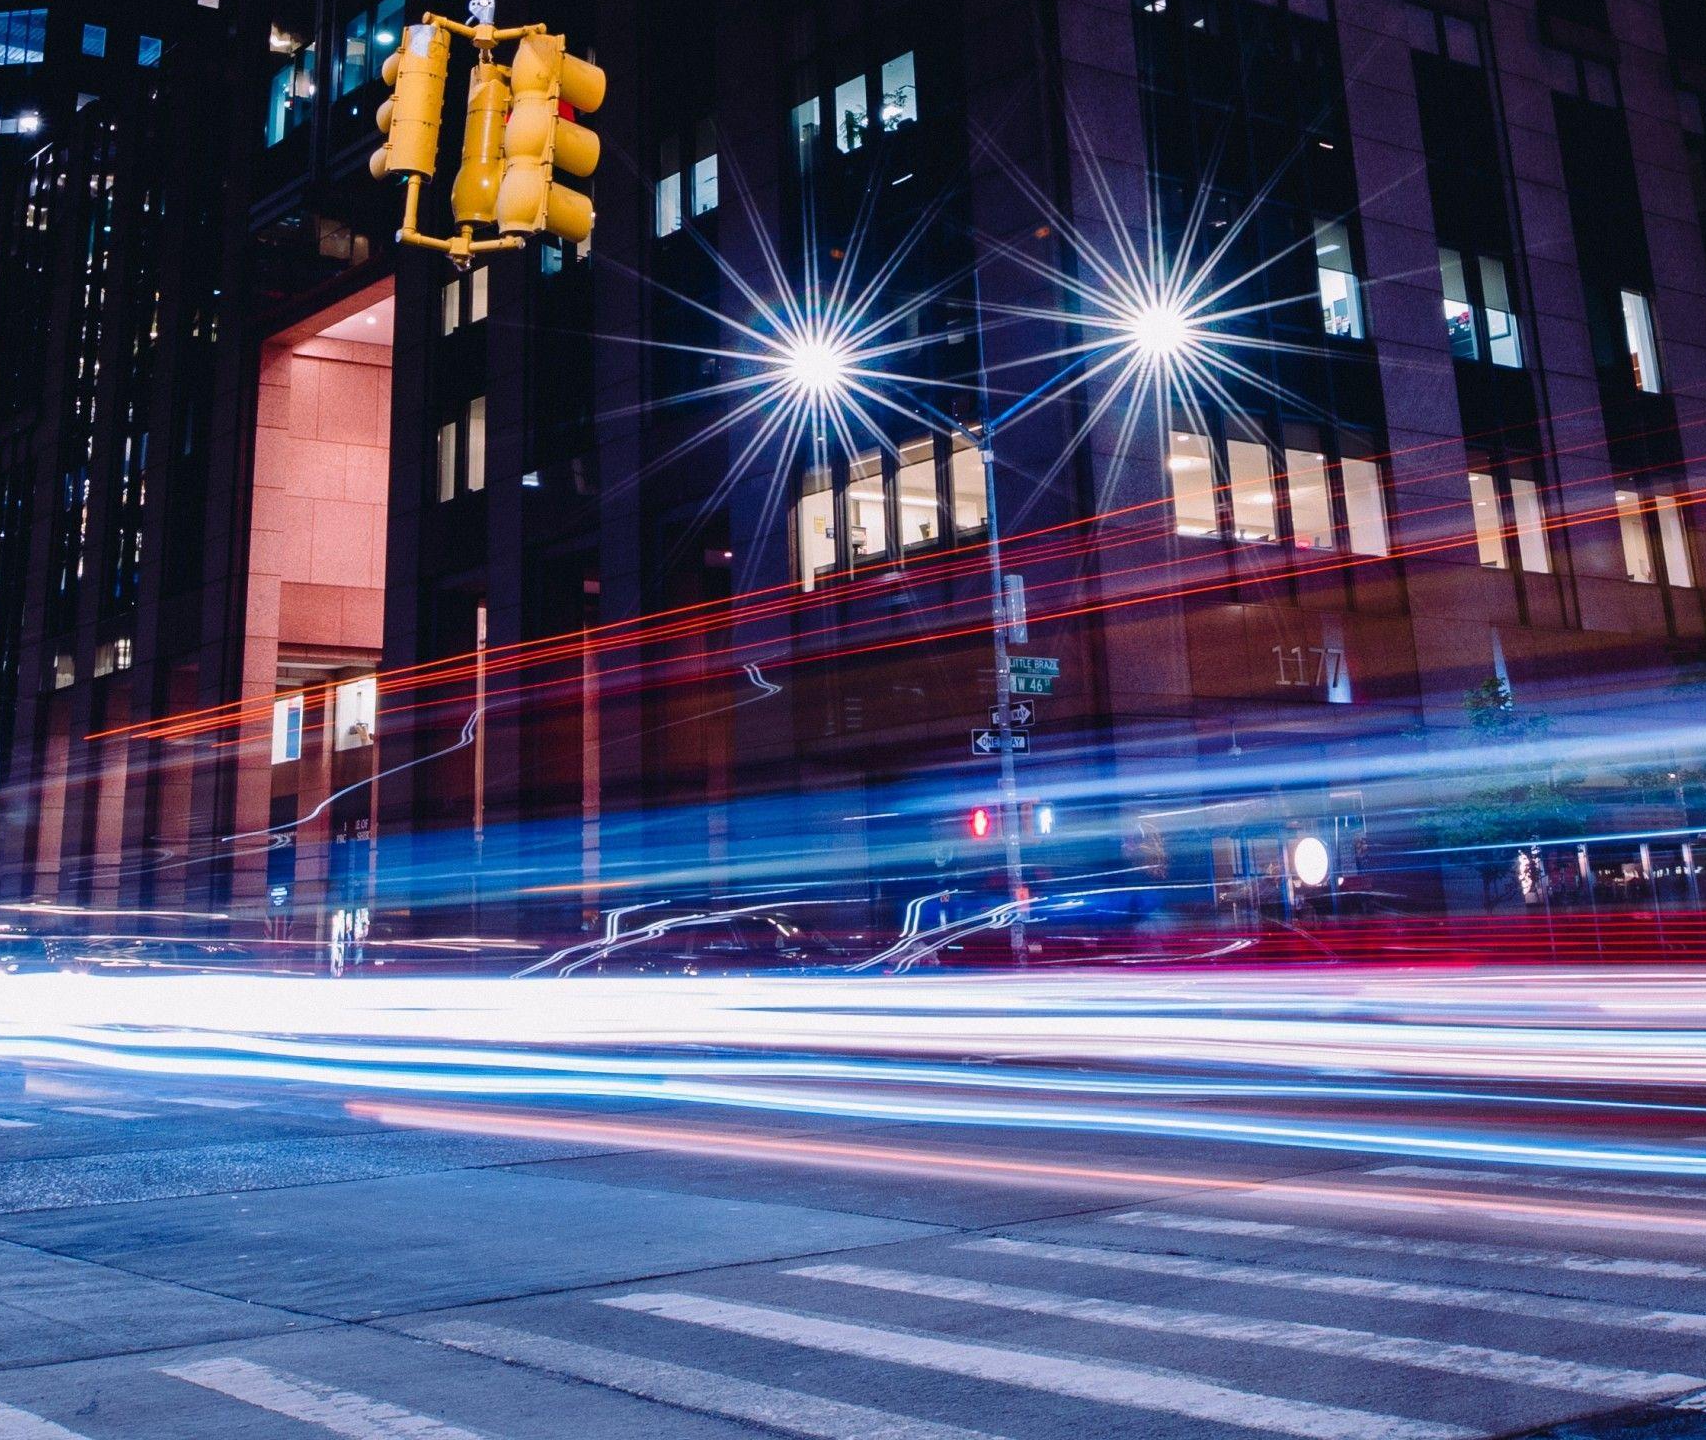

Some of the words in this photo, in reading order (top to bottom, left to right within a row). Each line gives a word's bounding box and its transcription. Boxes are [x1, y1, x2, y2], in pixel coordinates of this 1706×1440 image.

[1010, 660, 1031, 669] LITTLE
[1034, 661, 1059, 670] BRAZIL
[1272, 645, 1344, 689] 1177
[1017, 678, 1025, 691] W
[1030, 679, 1043, 692] 46
